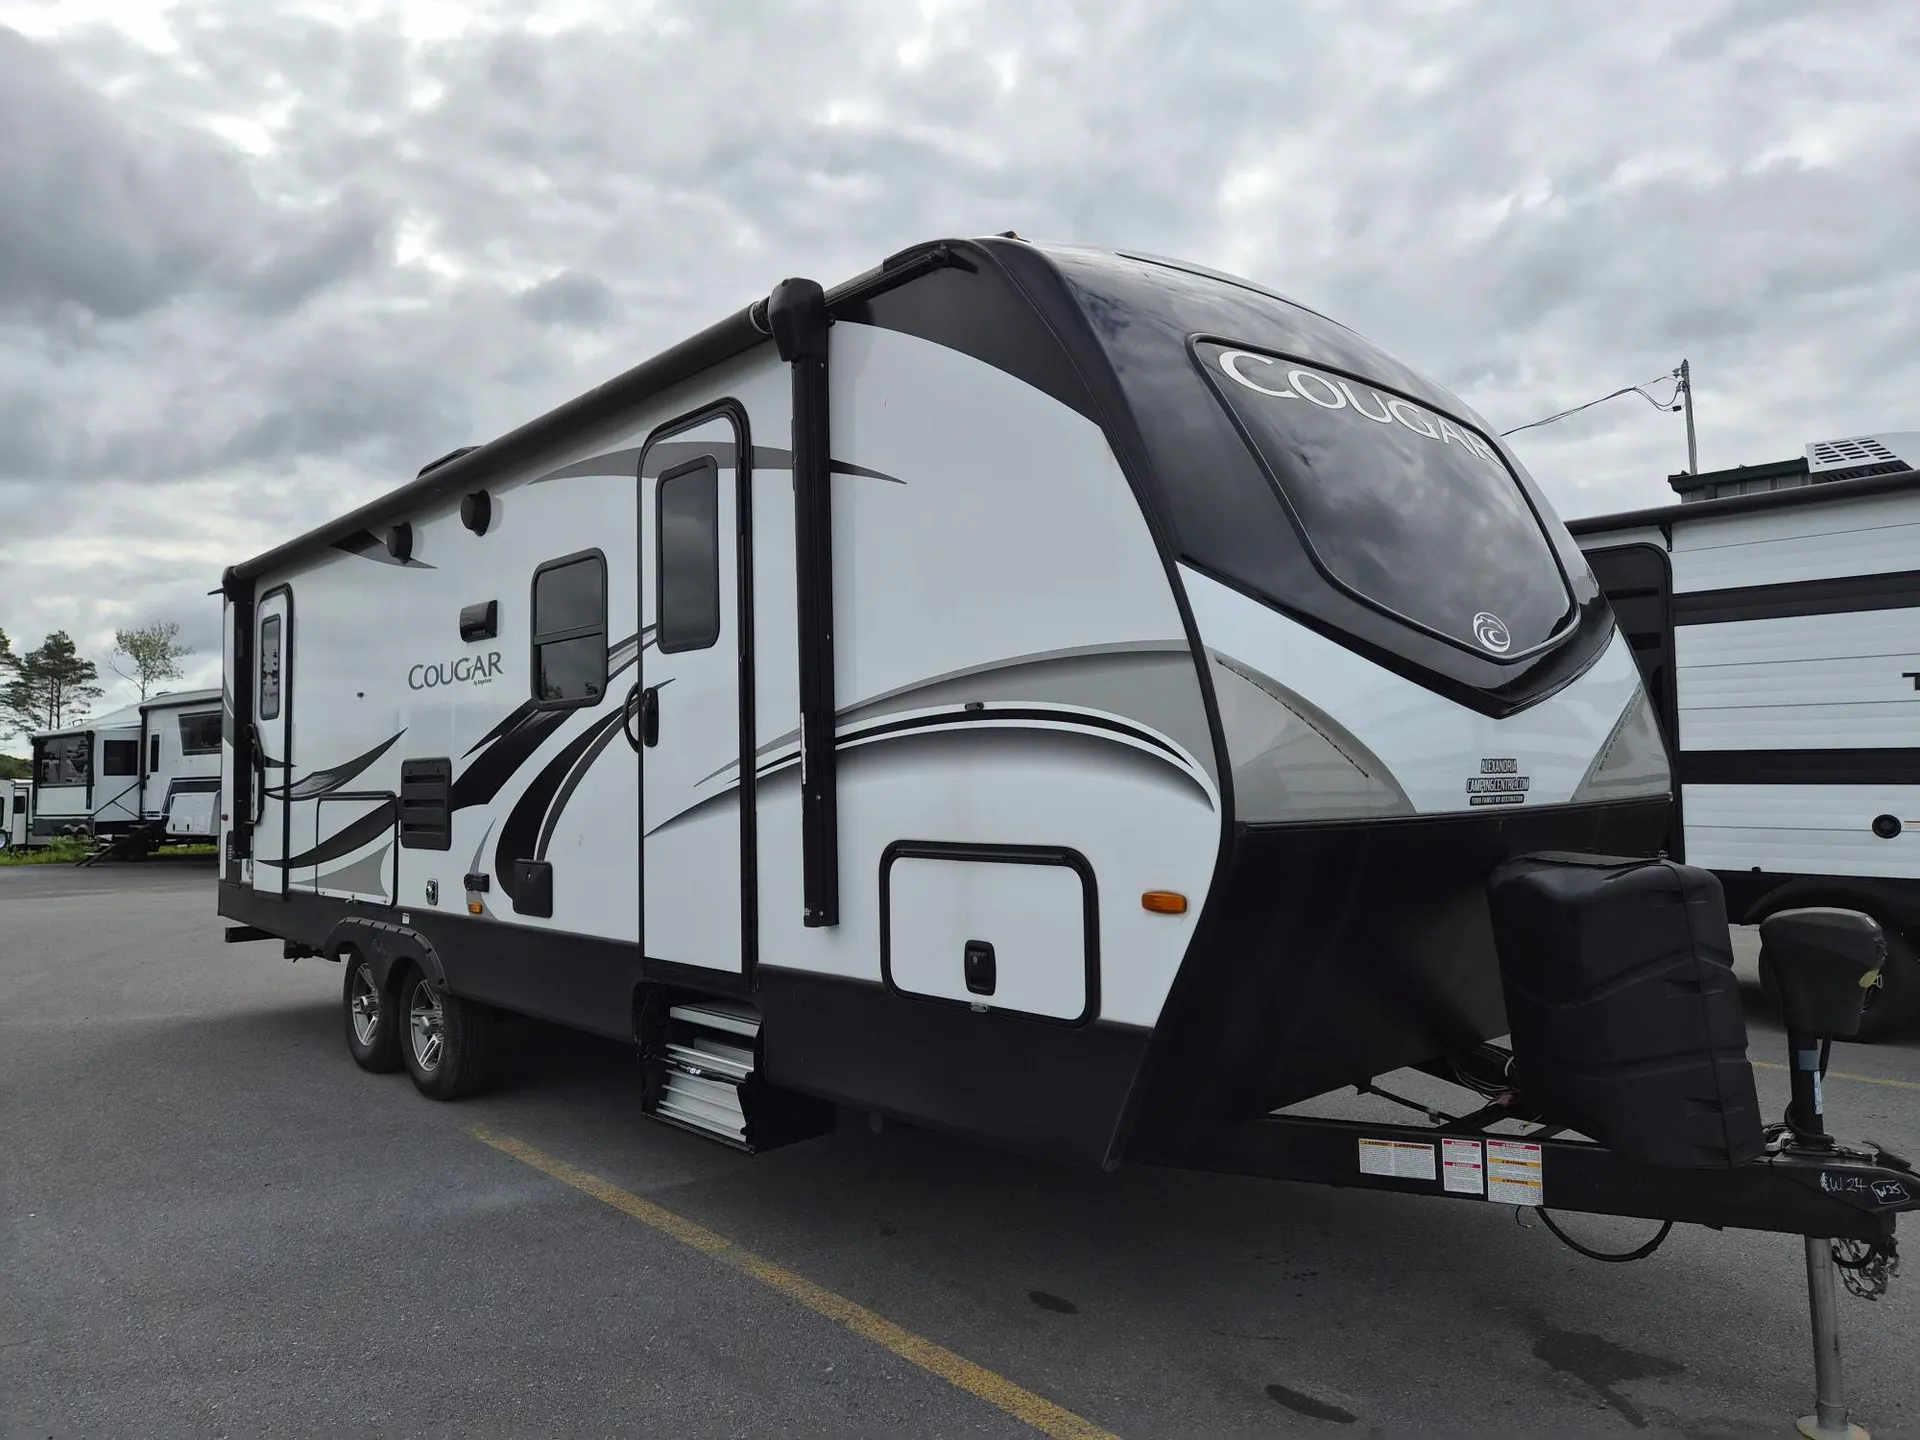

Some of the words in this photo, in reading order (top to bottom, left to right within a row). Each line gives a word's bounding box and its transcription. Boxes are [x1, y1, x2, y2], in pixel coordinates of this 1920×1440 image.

[1218, 350, 1506, 469] COUGAR
[408, 651, 505, 690] COUGAR
[1480, 759, 1518, 773] ALEXANDRIA
